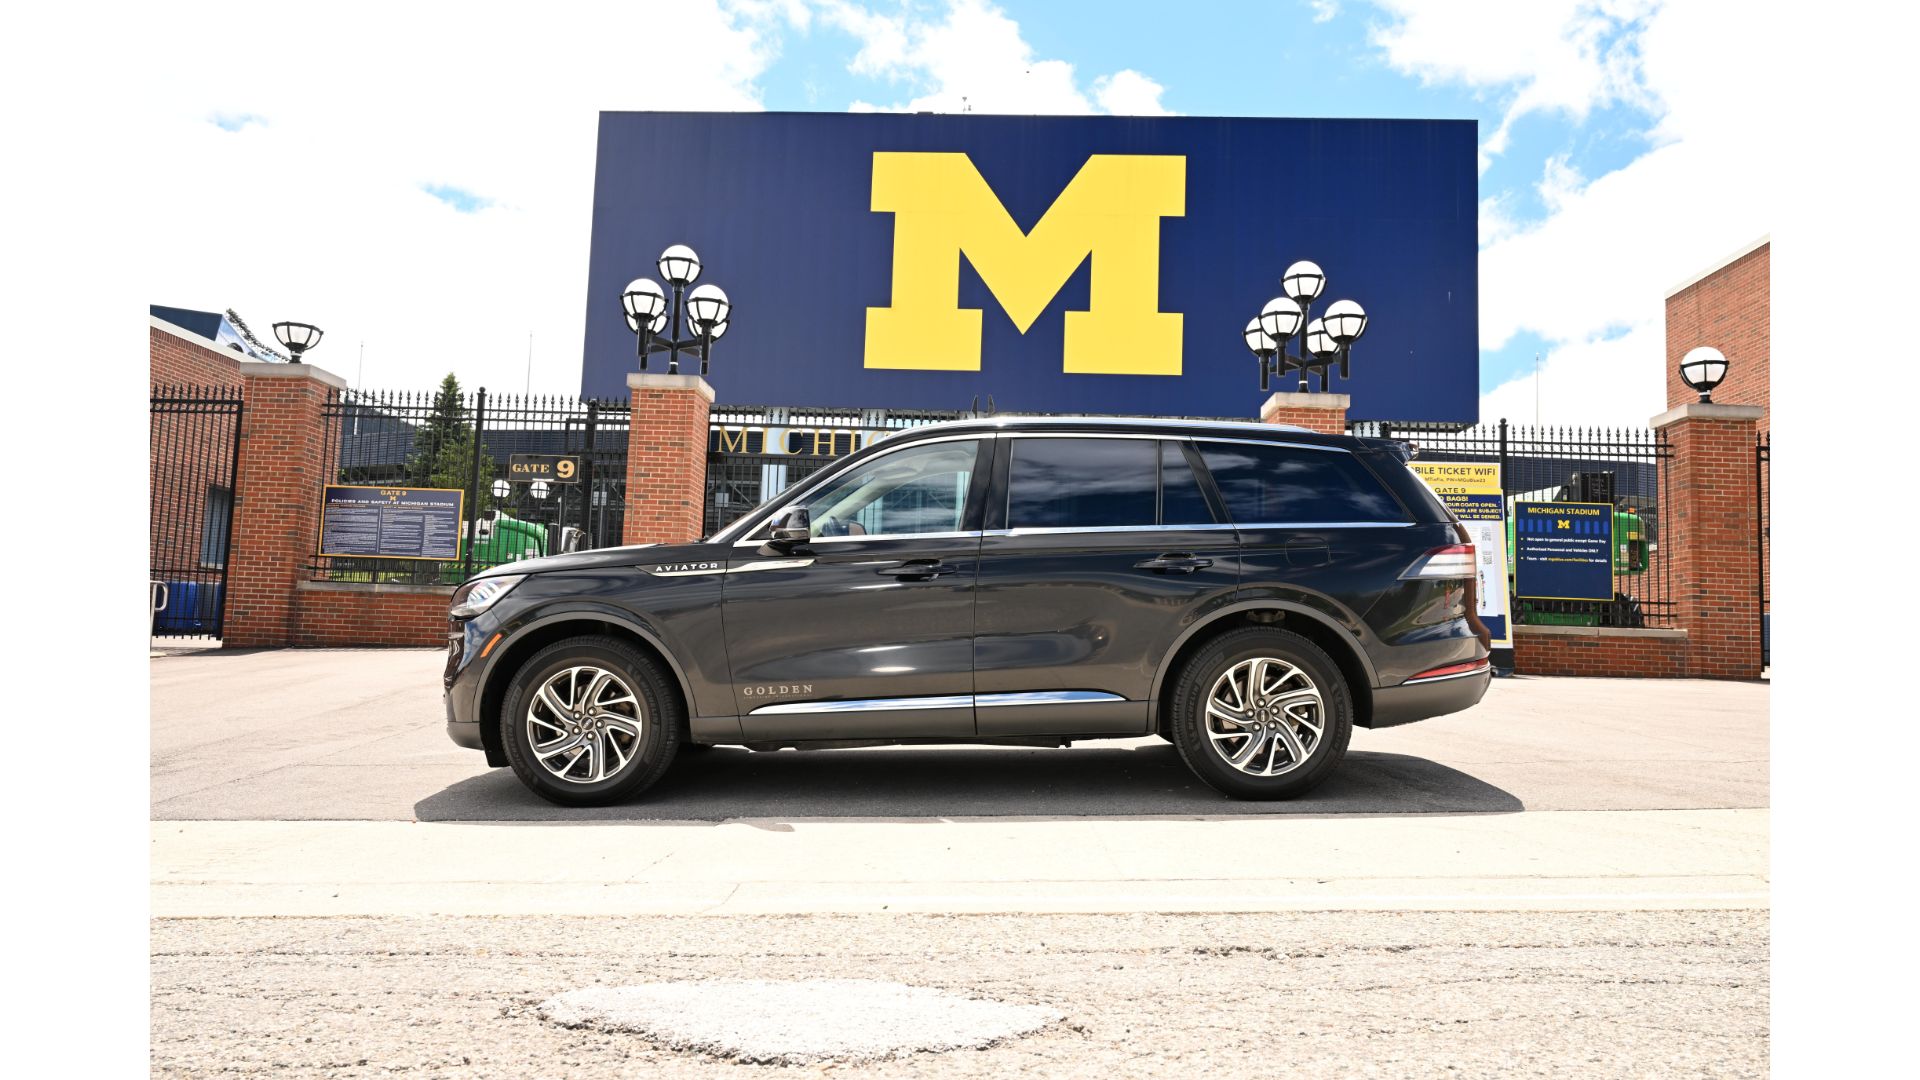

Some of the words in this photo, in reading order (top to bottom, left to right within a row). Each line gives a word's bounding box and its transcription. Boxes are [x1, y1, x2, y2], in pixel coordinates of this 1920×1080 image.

[863, 151, 1187, 376] M
[512, 463, 550, 473] GATE
[556, 459, 575, 479] 9
[1411, 466, 1435, 475] BILE
[1438, 467, 1471, 476] TICKET
[1474, 467, 1496, 476] WIFI
[1527, 507, 1565, 515] MICHIGAN
[1566, 508, 1600, 516] STADIUM
[1557, 519, 1570, 529] M
[655, 562, 718, 572] AVIATOR
[743, 684, 813, 696] GOLDEN
